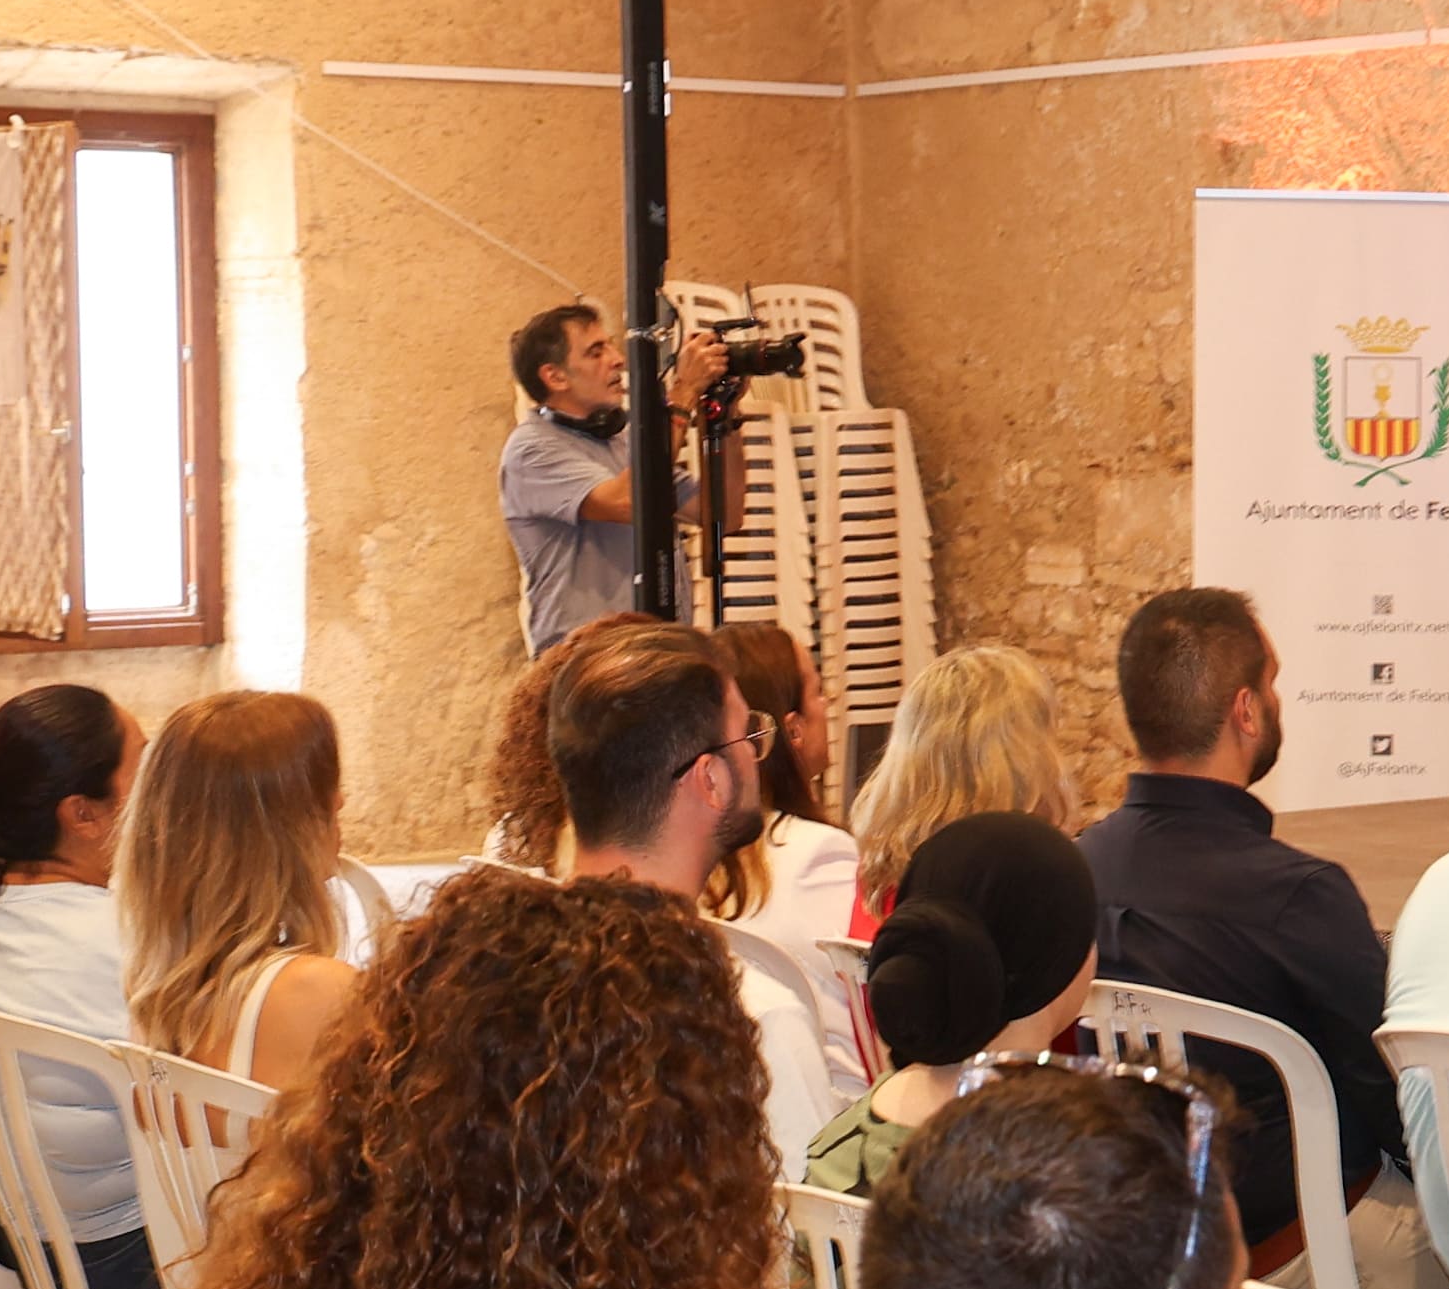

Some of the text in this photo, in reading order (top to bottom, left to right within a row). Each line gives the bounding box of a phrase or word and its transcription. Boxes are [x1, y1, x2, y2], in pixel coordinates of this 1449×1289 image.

[1246, 500, 1383, 525] Ajuntament
[1388, 499, 1420, 521] de
[1297, 688, 1384, 705] Ajuntament
[1386, 688, 1406, 703] de
